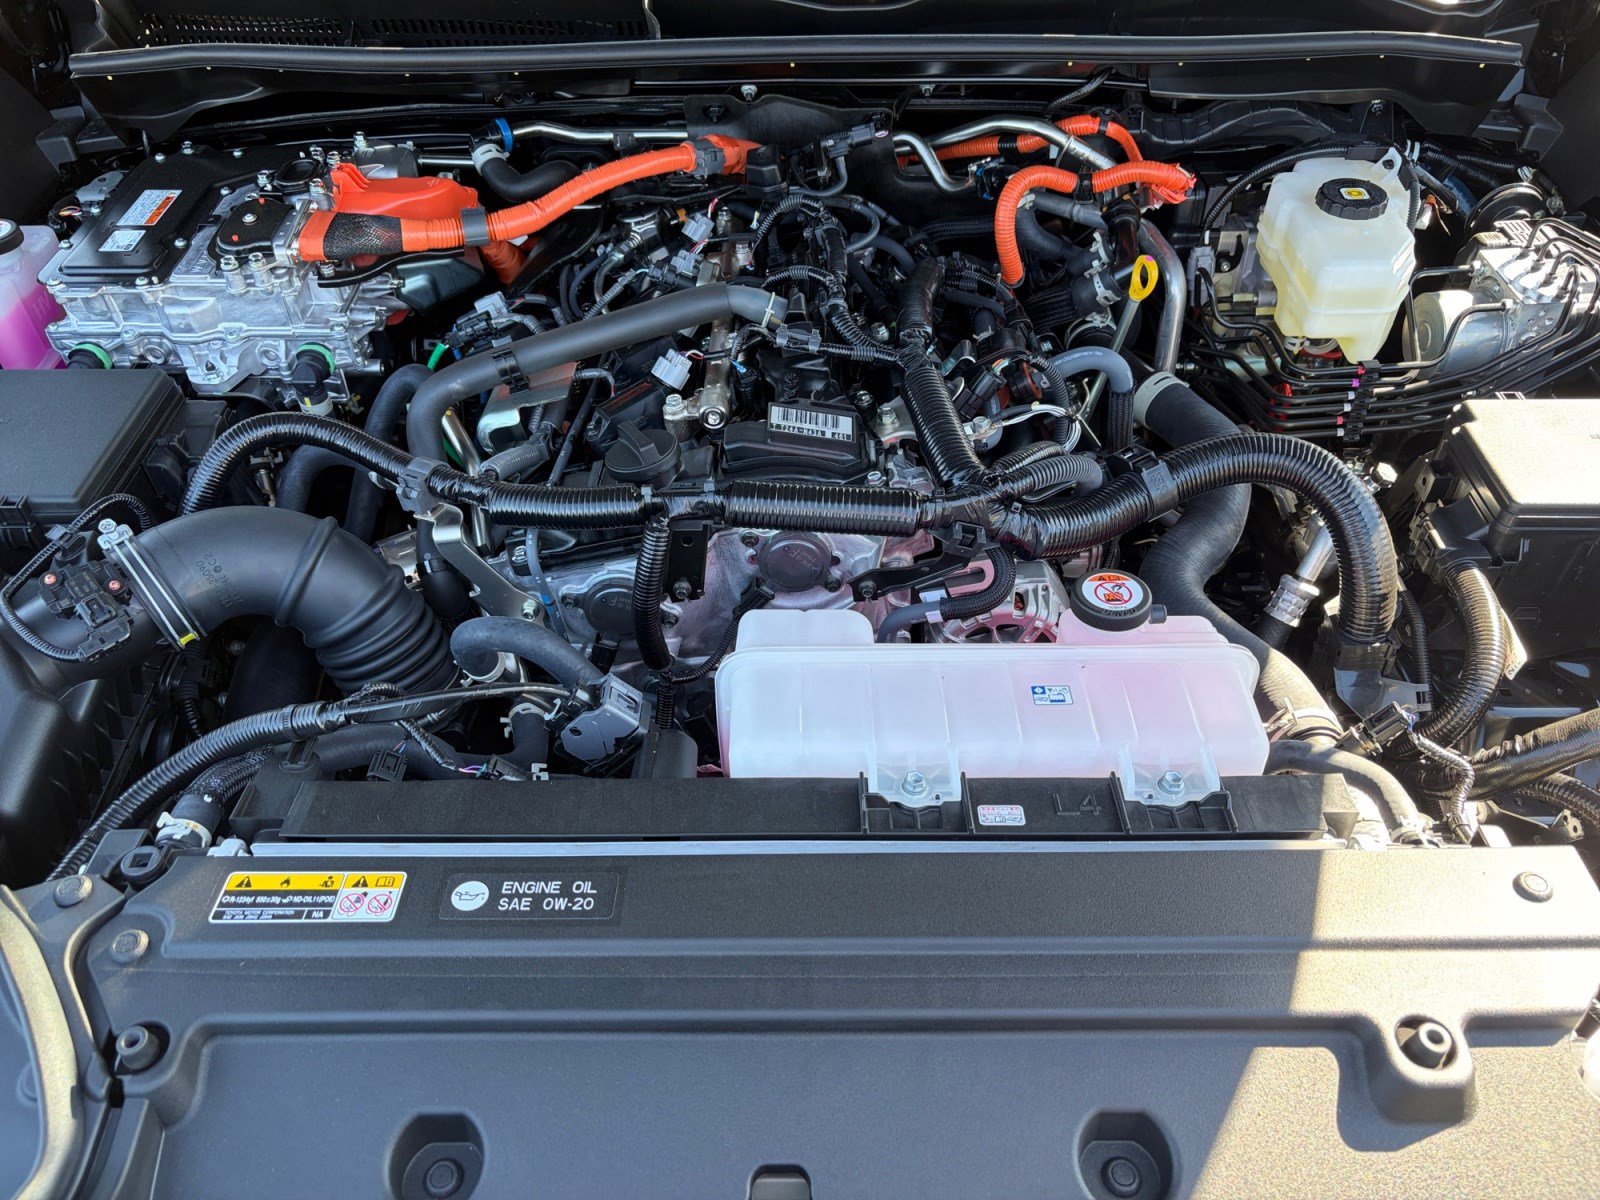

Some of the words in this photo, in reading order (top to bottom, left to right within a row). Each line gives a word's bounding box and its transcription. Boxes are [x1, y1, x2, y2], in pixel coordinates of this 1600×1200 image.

[1052, 793, 1101, 816] L4
[501, 881, 562, 894] ENGINE
[572, 881, 597, 894] OIL
[498, 898, 533, 911] SAE
[542, 898, 595, 911] 0W-20
[311, 910, 324, 918] NA
